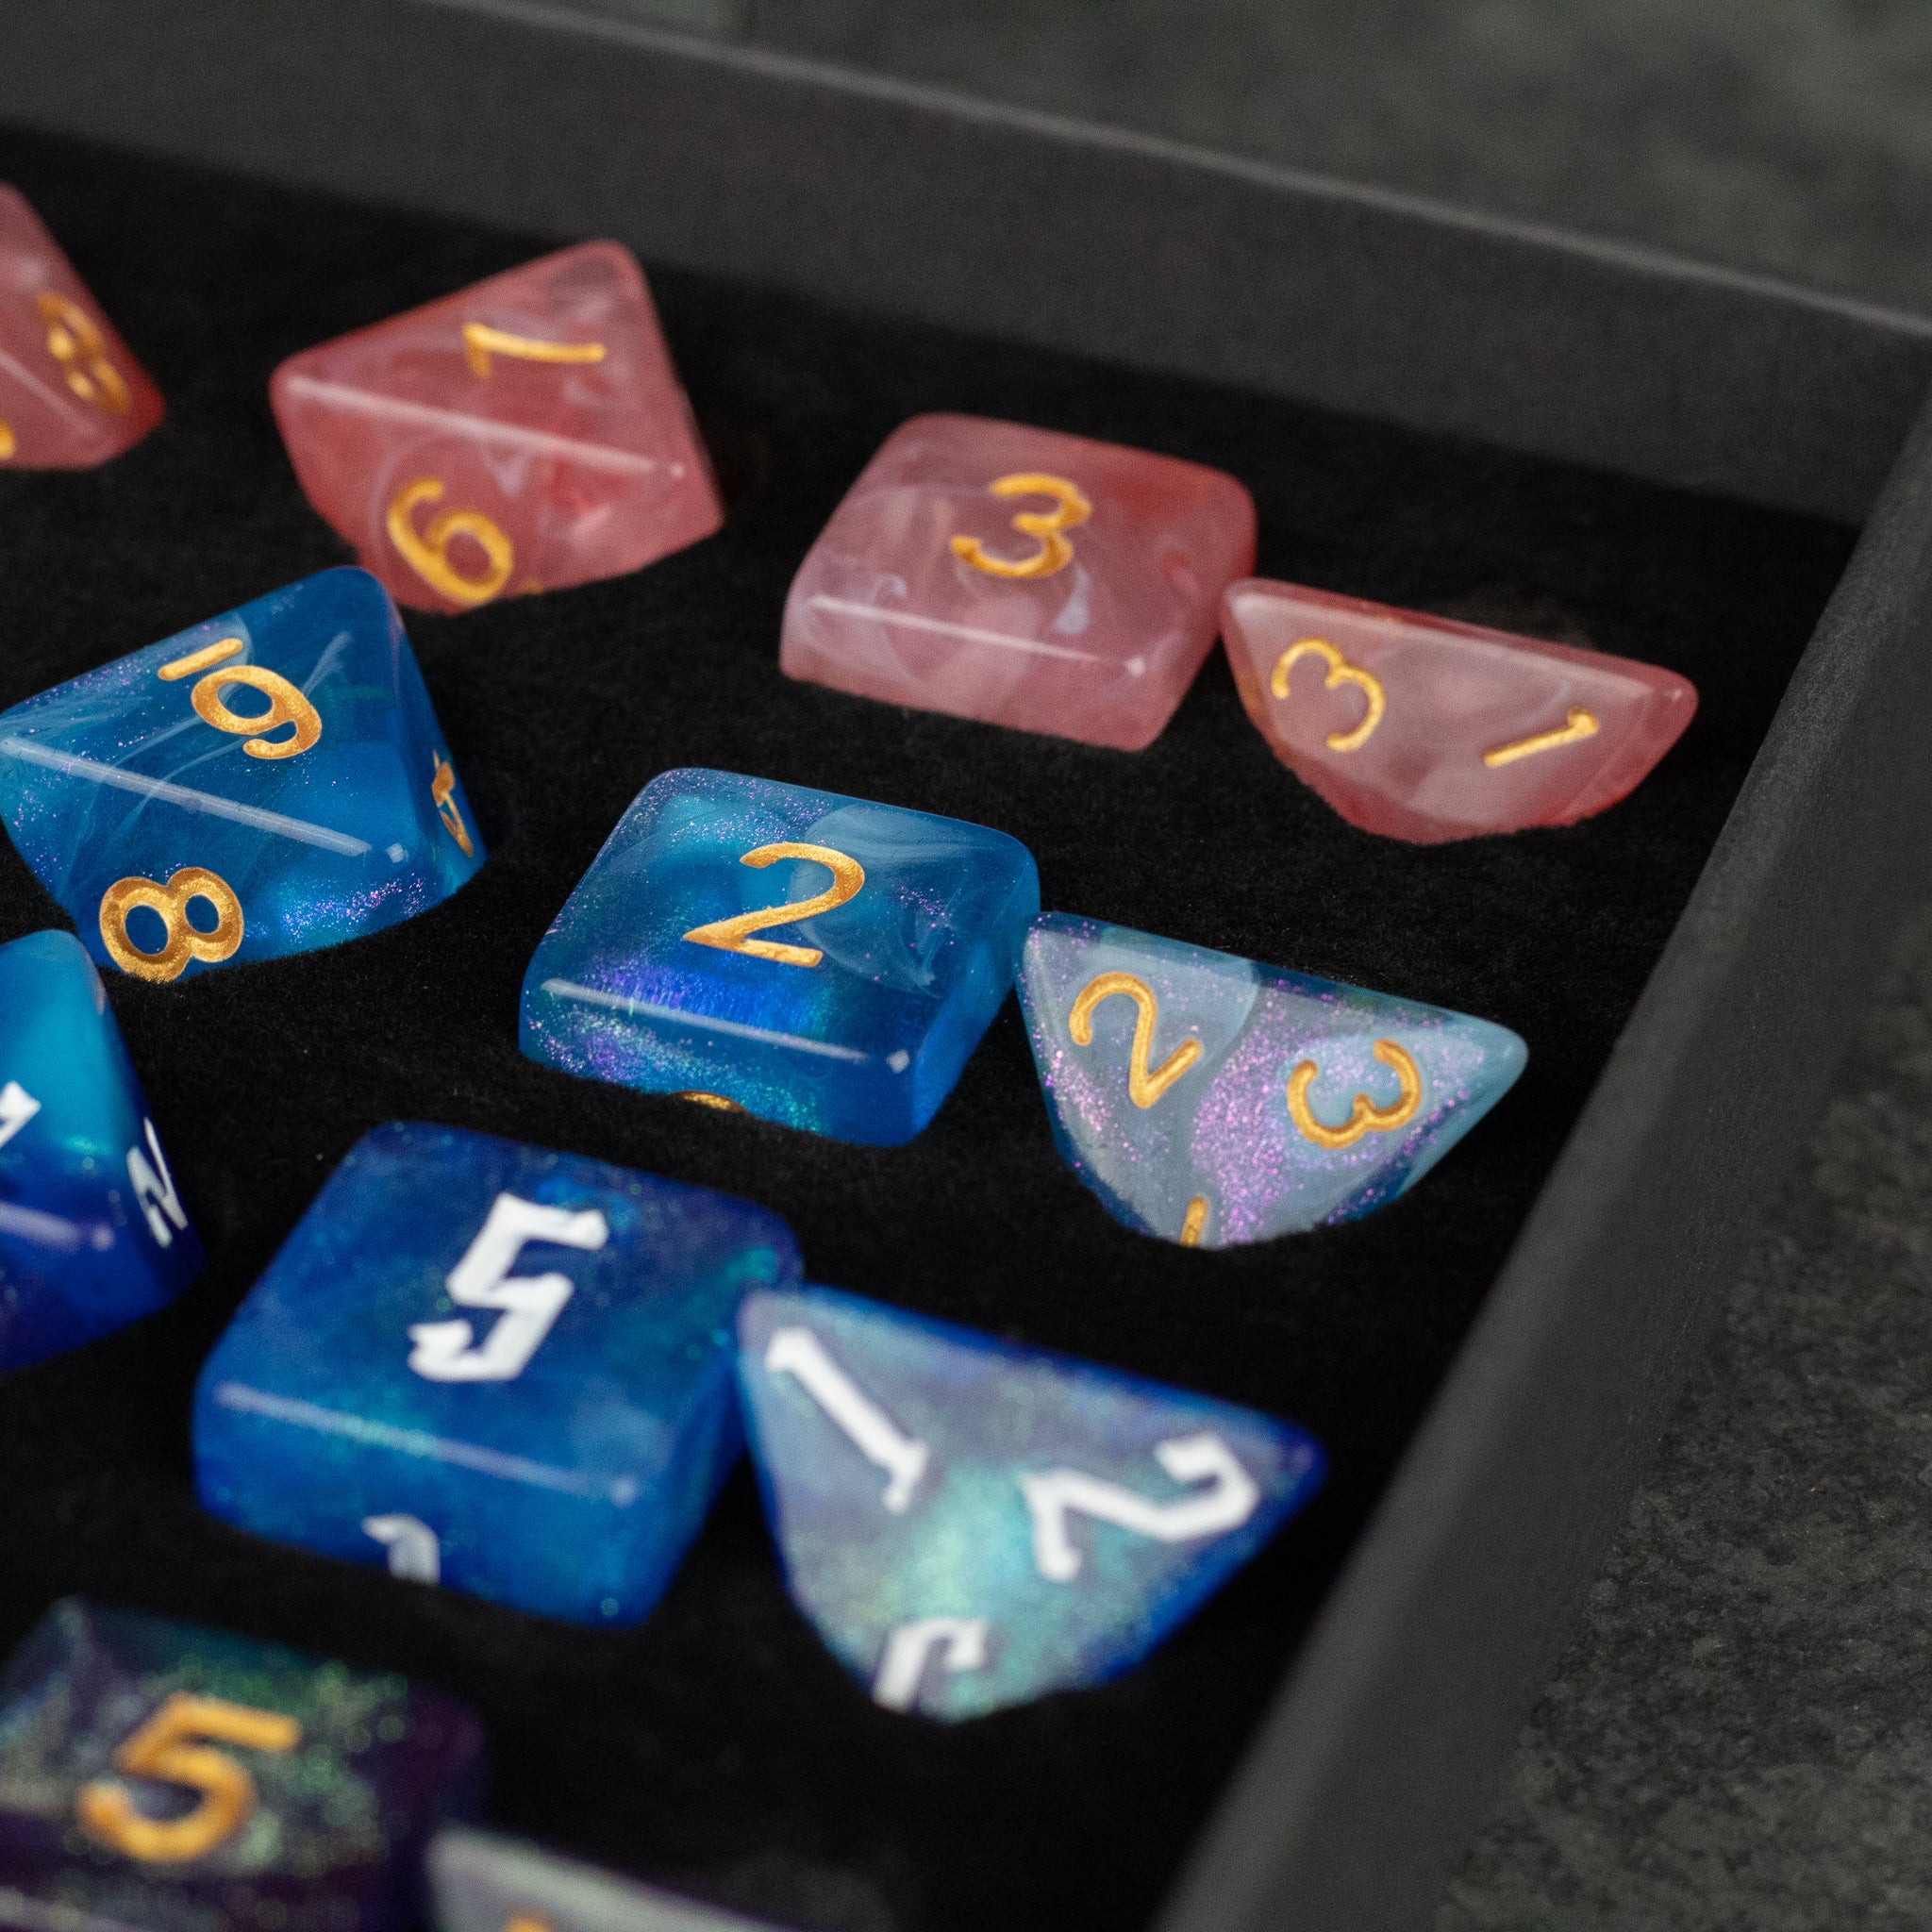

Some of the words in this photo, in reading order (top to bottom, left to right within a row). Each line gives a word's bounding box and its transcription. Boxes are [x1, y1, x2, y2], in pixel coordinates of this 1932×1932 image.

[462, 322, 607, 379] 7
[388, 478, 512, 607] 6
[950, 473, 1092, 578] 3
[1271, 638, 1387, 752] 3
[1484, 708, 1599, 767] 1
[99, 866, 244, 983] 8
[681, 841, 865, 968] 2
[1069, 971, 1204, 1108] 2
[1286, 1039, 1422, 1150] 3
[408, 1193, 608, 1381] 5
[765, 1326, 929, 1511] 1
[1016, 1432, 1260, 1582] 2
[76, 1690, 303, 1864] 5
